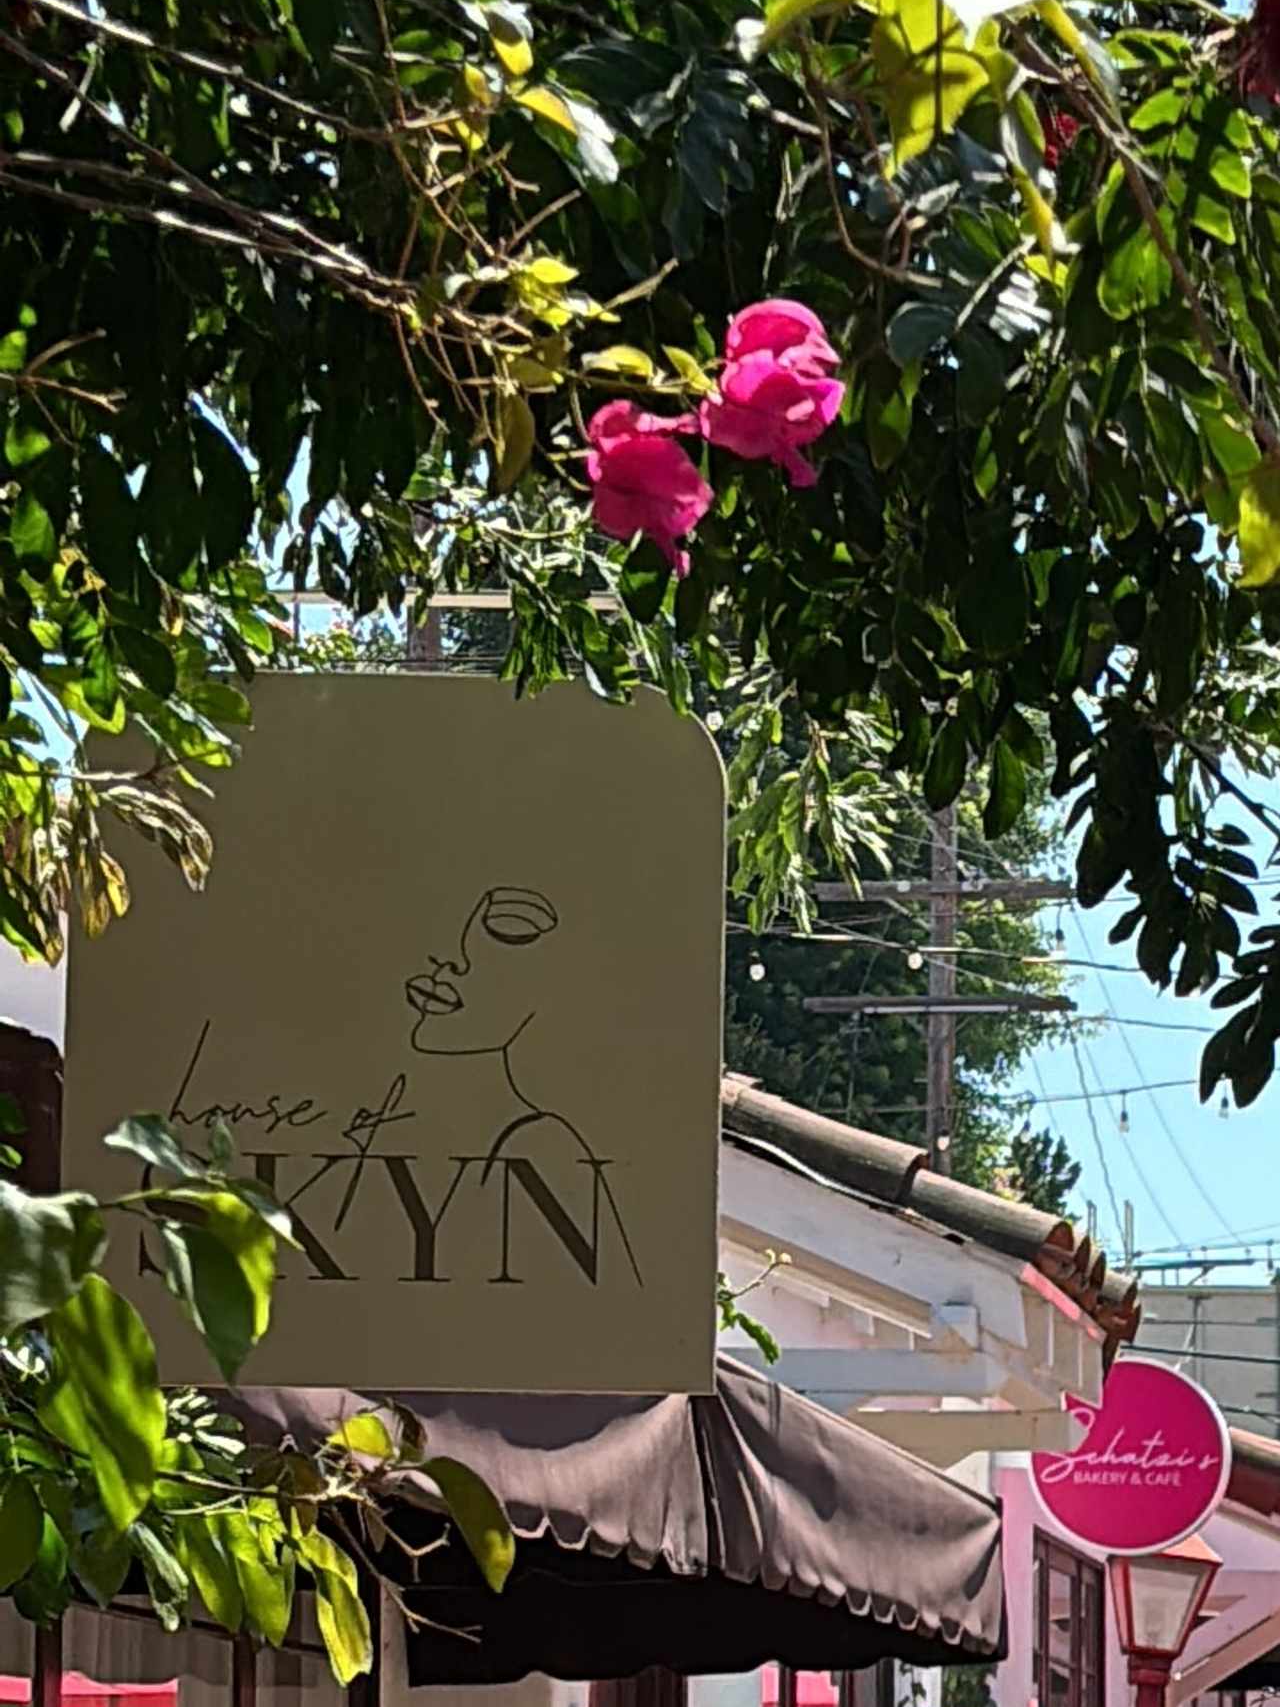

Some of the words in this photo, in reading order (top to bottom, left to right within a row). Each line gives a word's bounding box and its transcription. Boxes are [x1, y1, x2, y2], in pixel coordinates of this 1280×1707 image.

[168, 1020, 328, 1134] house
[334, 1073, 416, 1232] of
[1073, 1470, 1125, 1486] BAKERY
[1130, 1471, 1142, 1486] &
